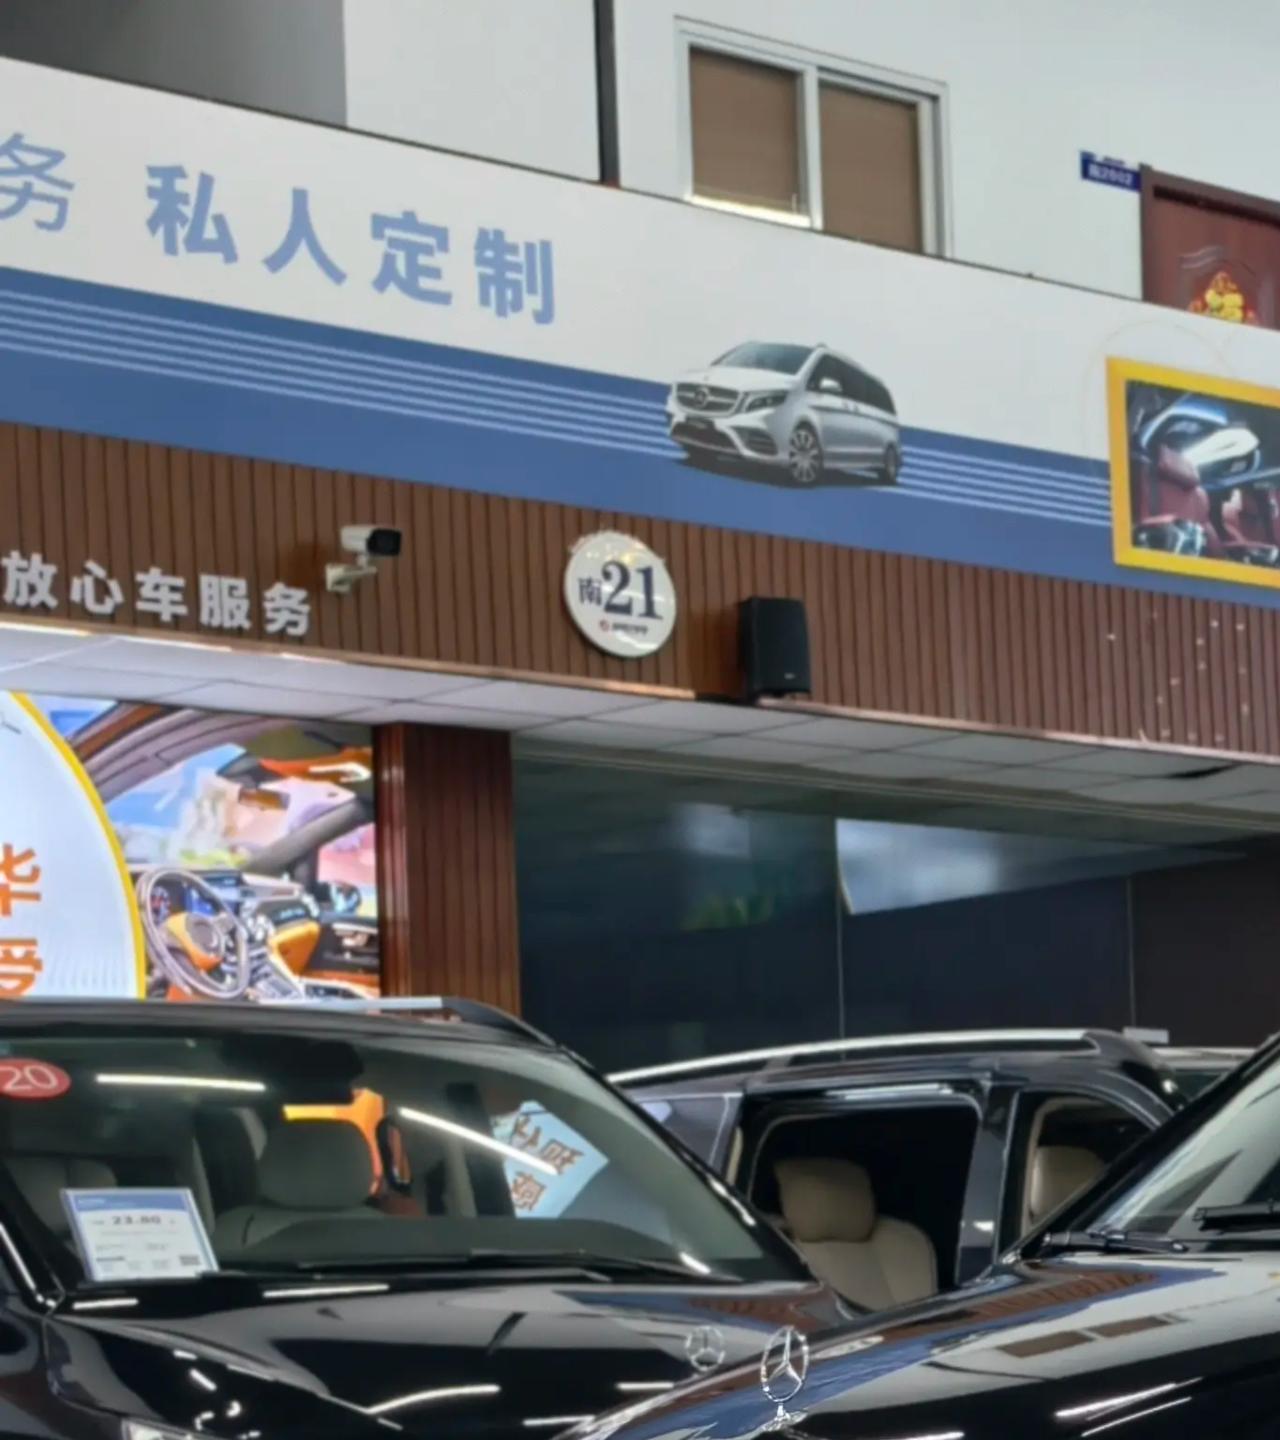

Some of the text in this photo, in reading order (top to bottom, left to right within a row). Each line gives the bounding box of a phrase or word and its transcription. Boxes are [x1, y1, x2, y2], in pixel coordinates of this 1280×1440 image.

[0, 132, 555, 325] 务 私人定制
[3, 549, 312, 637] 放心车服务
